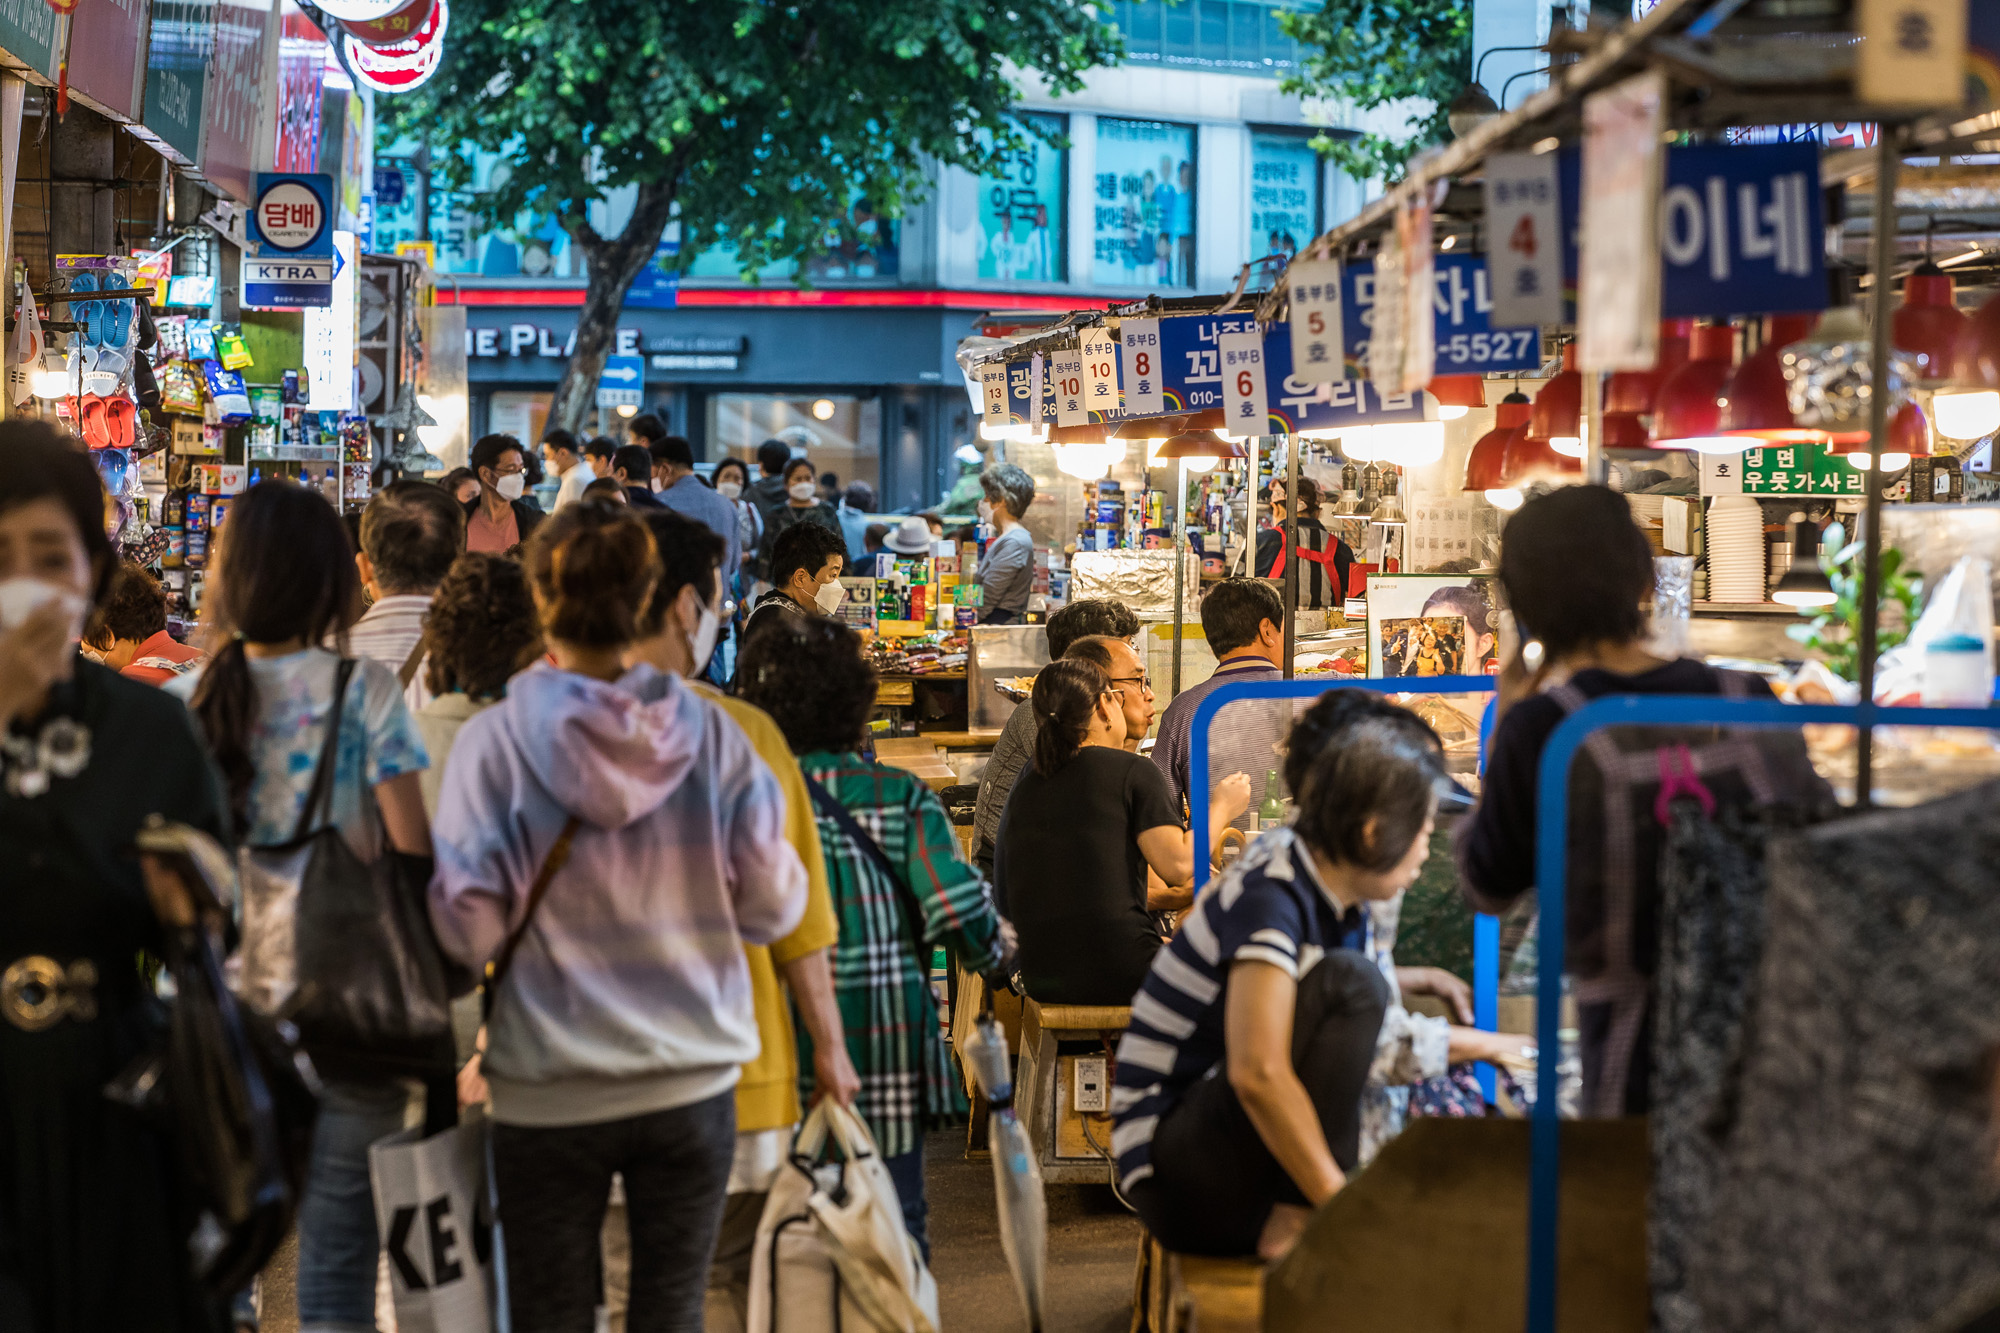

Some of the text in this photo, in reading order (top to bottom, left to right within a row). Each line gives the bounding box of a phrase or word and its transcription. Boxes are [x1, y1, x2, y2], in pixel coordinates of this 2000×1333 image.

[265, 203, 315, 229] 담배
[1663, 171, 1812, 282] 이네
[1508, 213, 1539, 259] 4
[259, 266, 317, 279] KTRA
[1295, 283, 1337, 304] 동부B
[1308, 311, 1325, 335] 5
[510, 323, 641, 357] PLE
[1126, 333, 1157, 347] 동부B
[1084, 343, 1113, 355] 동부B
[1226, 349, 1260, 365] 동부B
[1307, 341, 1330, 365] 호
[1056, 361, 1081, 374] 동부B
[1090, 362, 1111, 378] 10
[1135, 352, 1150, 376] 8
[1184, 350, 1223, 384] 꼬
[983, 372, 1005, 382] 동부B
[1236, 370, 1253, 397] 6
[988, 388, 1002, 399] 13
[1059, 377, 1080, 396] 10
[1094, 382, 1110, 396] 호
[1138, 379, 1152, 395] 호
[990, 402, 1003, 415] 호
[1067, 399, 1079, 412] 호
[1239, 401, 1256, 418] 호
[1715, 463, 1731, 478] 호
[1743, 472, 1866, 493] 우뭇가사리
